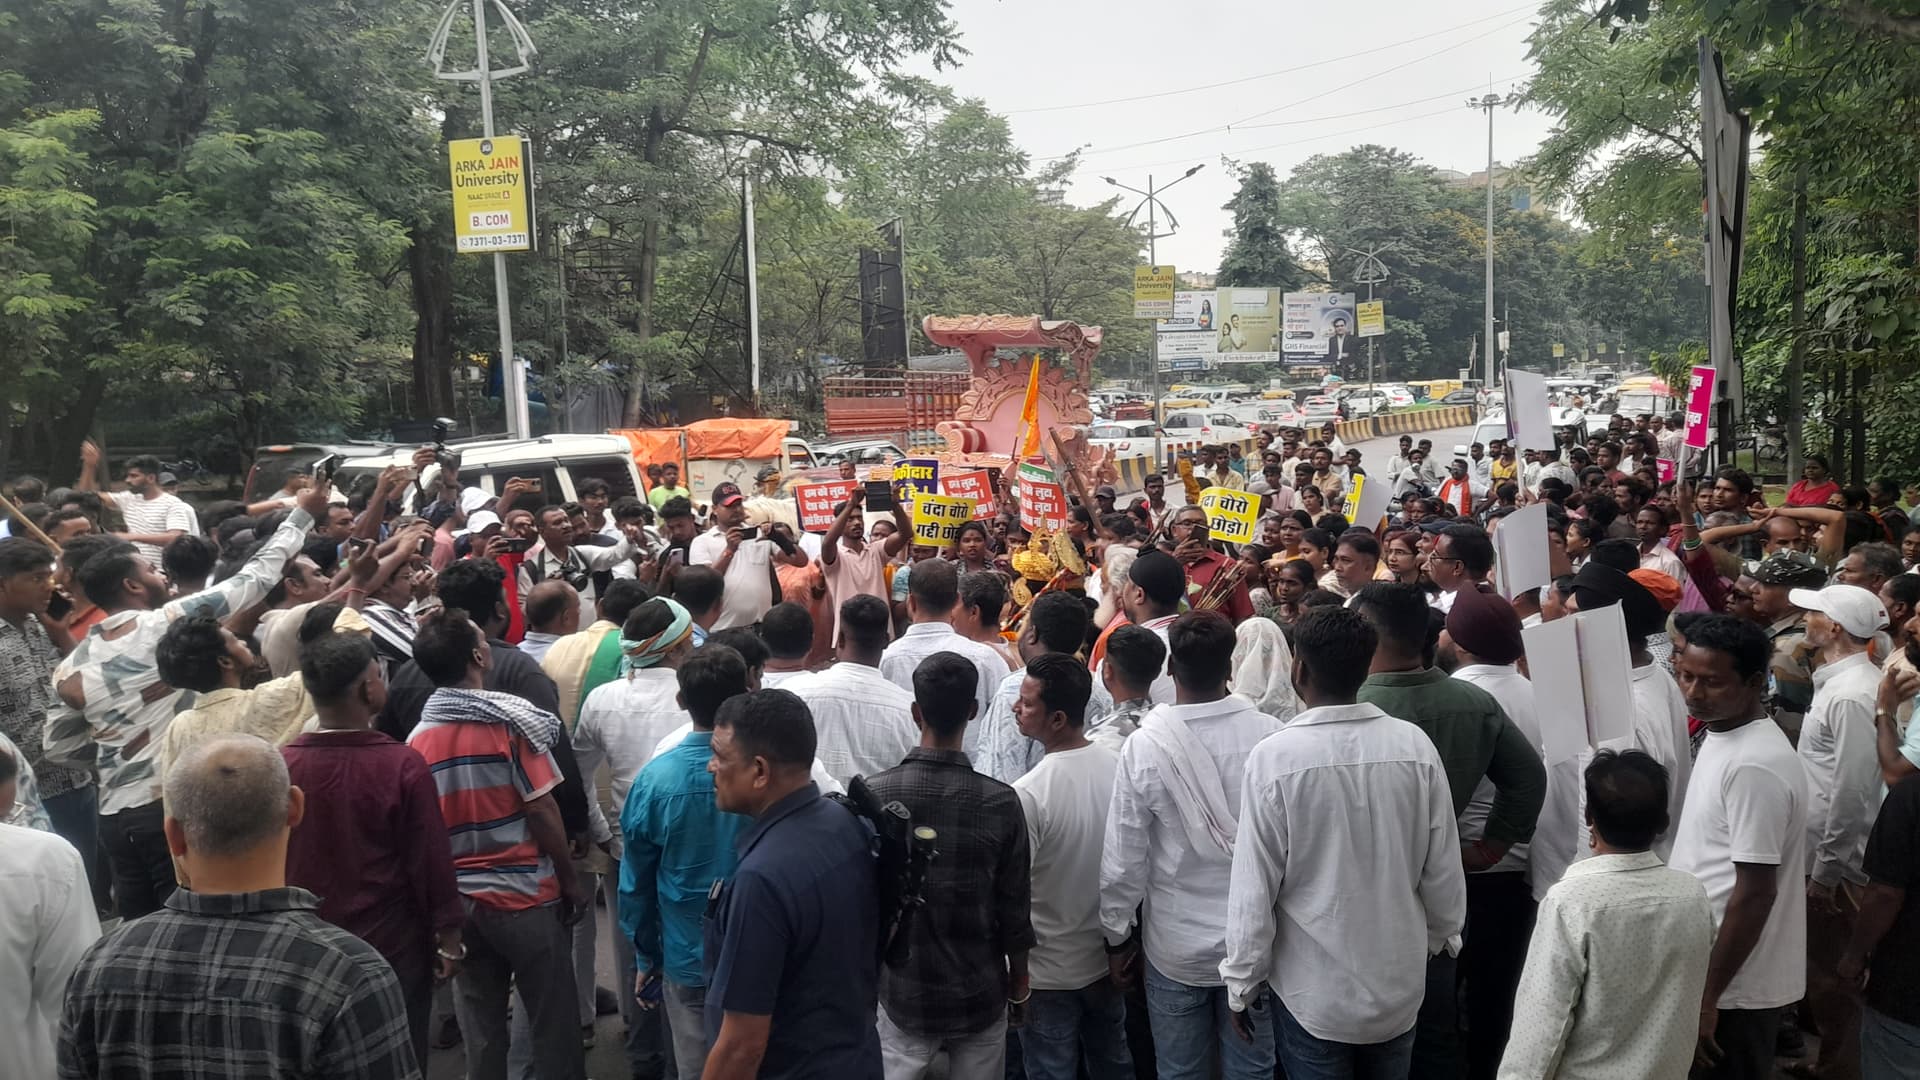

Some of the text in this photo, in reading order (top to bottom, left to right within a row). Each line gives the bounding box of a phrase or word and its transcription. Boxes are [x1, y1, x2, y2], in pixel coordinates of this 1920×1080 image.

[456, 156, 519, 172] ARKA JAIN
[456, 171, 519, 188] University
[485, 214, 509, 227] COM
[469, 234, 526, 247] 7371-03-7371
[1136, 282, 1172, 290] University
[922, 499, 945, 517] चंदा
[949, 502, 968, 518] चोरो
[1220, 494, 1249, 514] चोरो
